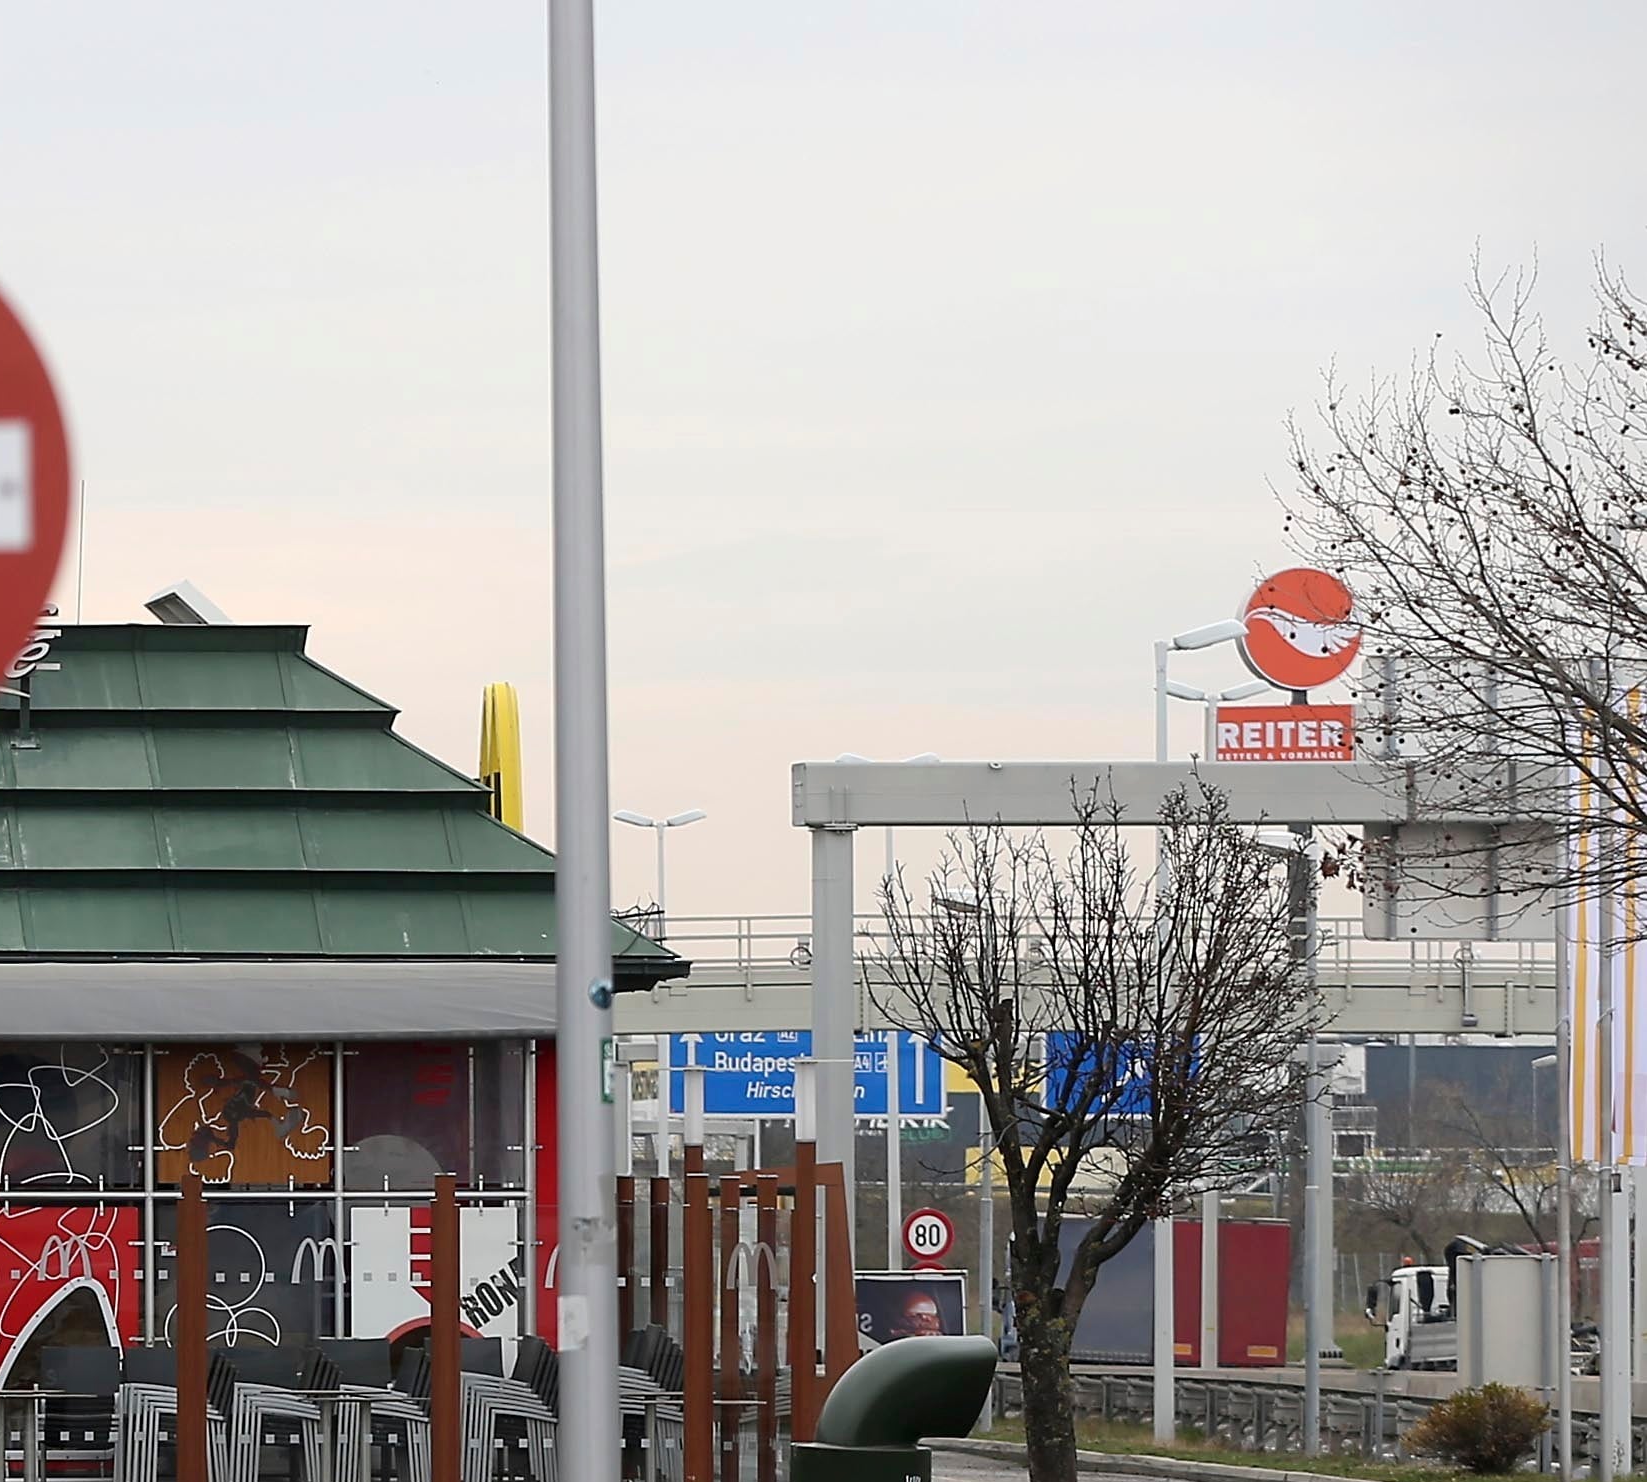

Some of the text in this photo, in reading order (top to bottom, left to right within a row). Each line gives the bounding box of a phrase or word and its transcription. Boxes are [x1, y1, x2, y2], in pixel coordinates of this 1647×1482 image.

[1218, 720, 1344, 749] REITER
[1281, 750, 1344, 760] VORHÄNGE
[715, 1051, 806, 1077] Budapes
[914, 1223, 941, 1248] 80
